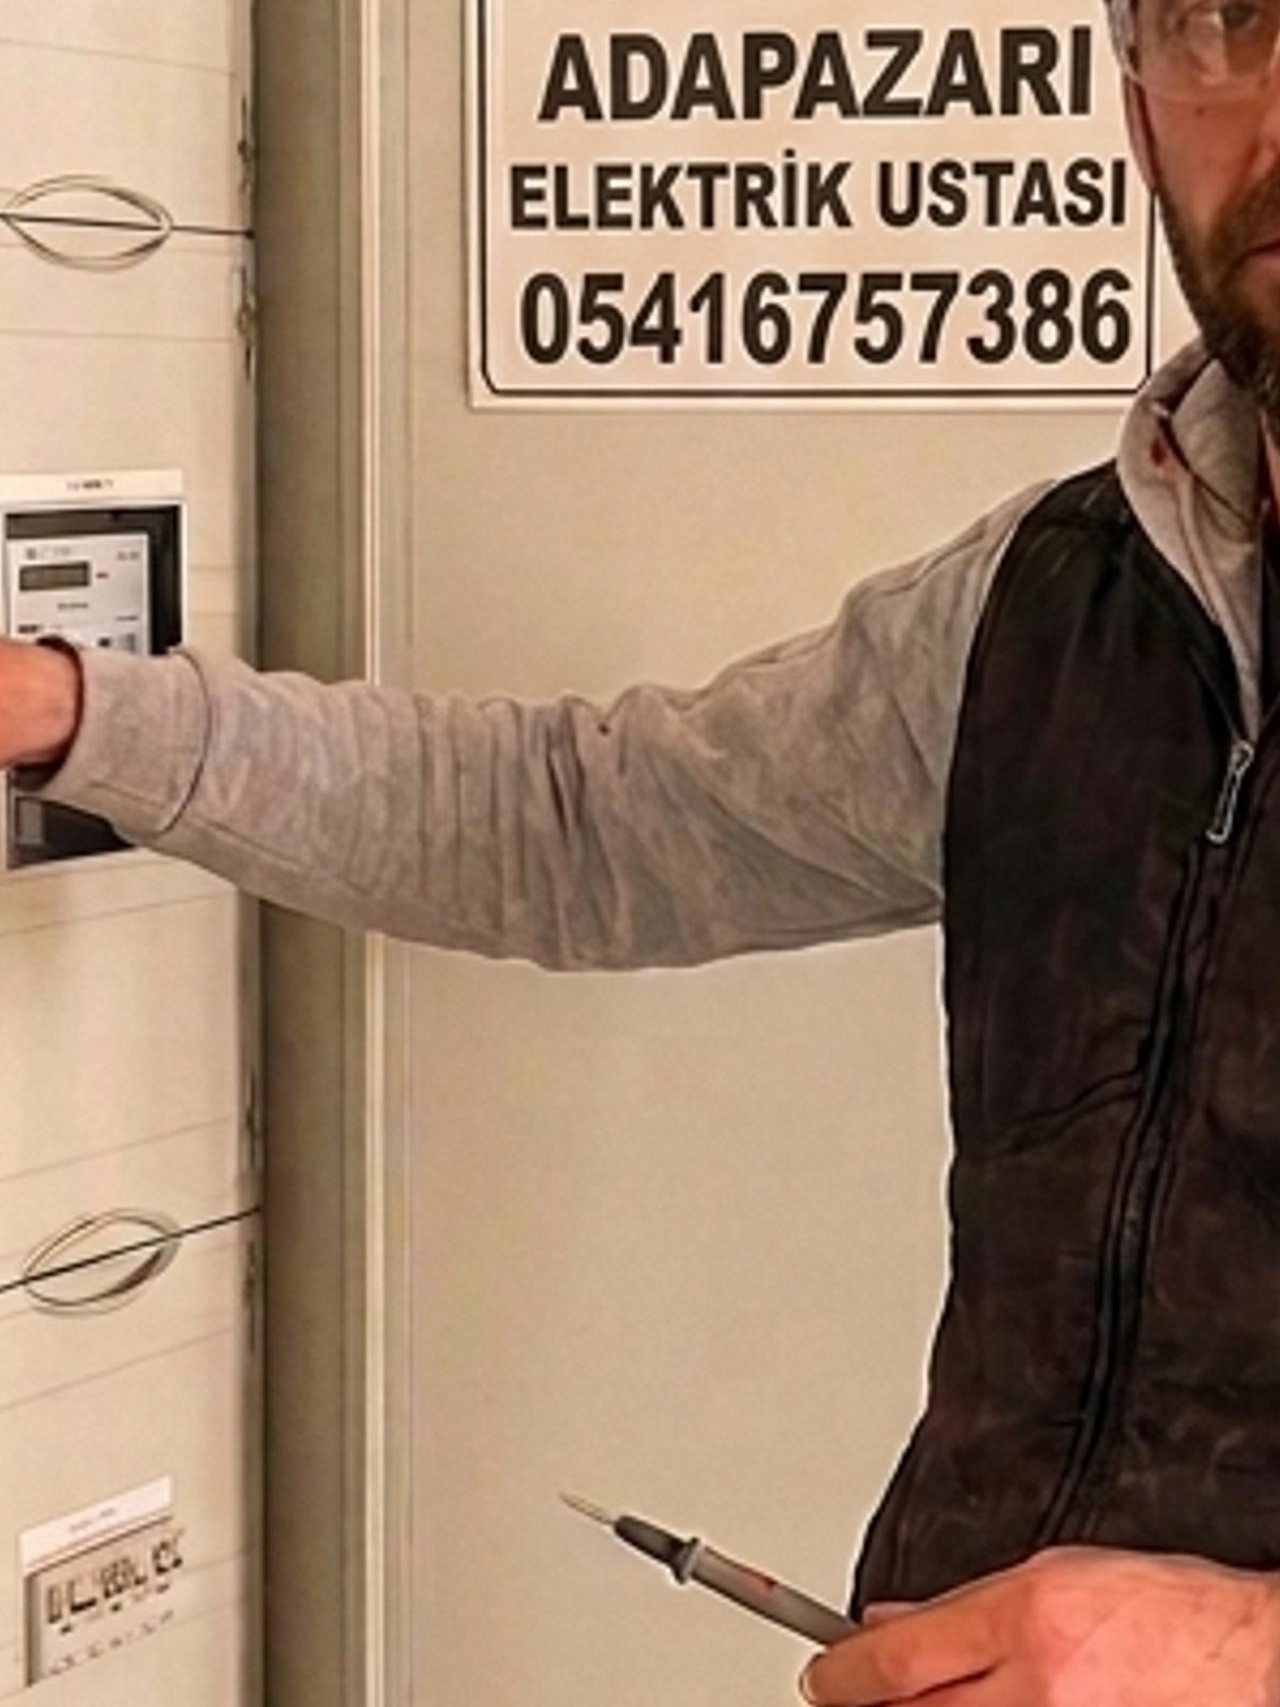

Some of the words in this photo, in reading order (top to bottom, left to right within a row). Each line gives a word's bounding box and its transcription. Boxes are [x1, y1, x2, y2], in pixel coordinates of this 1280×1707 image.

[537, 26, 1092, 122] ADAPAZARI
[510, 148, 852, 230] ELEKTRİK
[878, 159, 1126, 228] USTASI
[521, 268, 1132, 365] 05416757386
